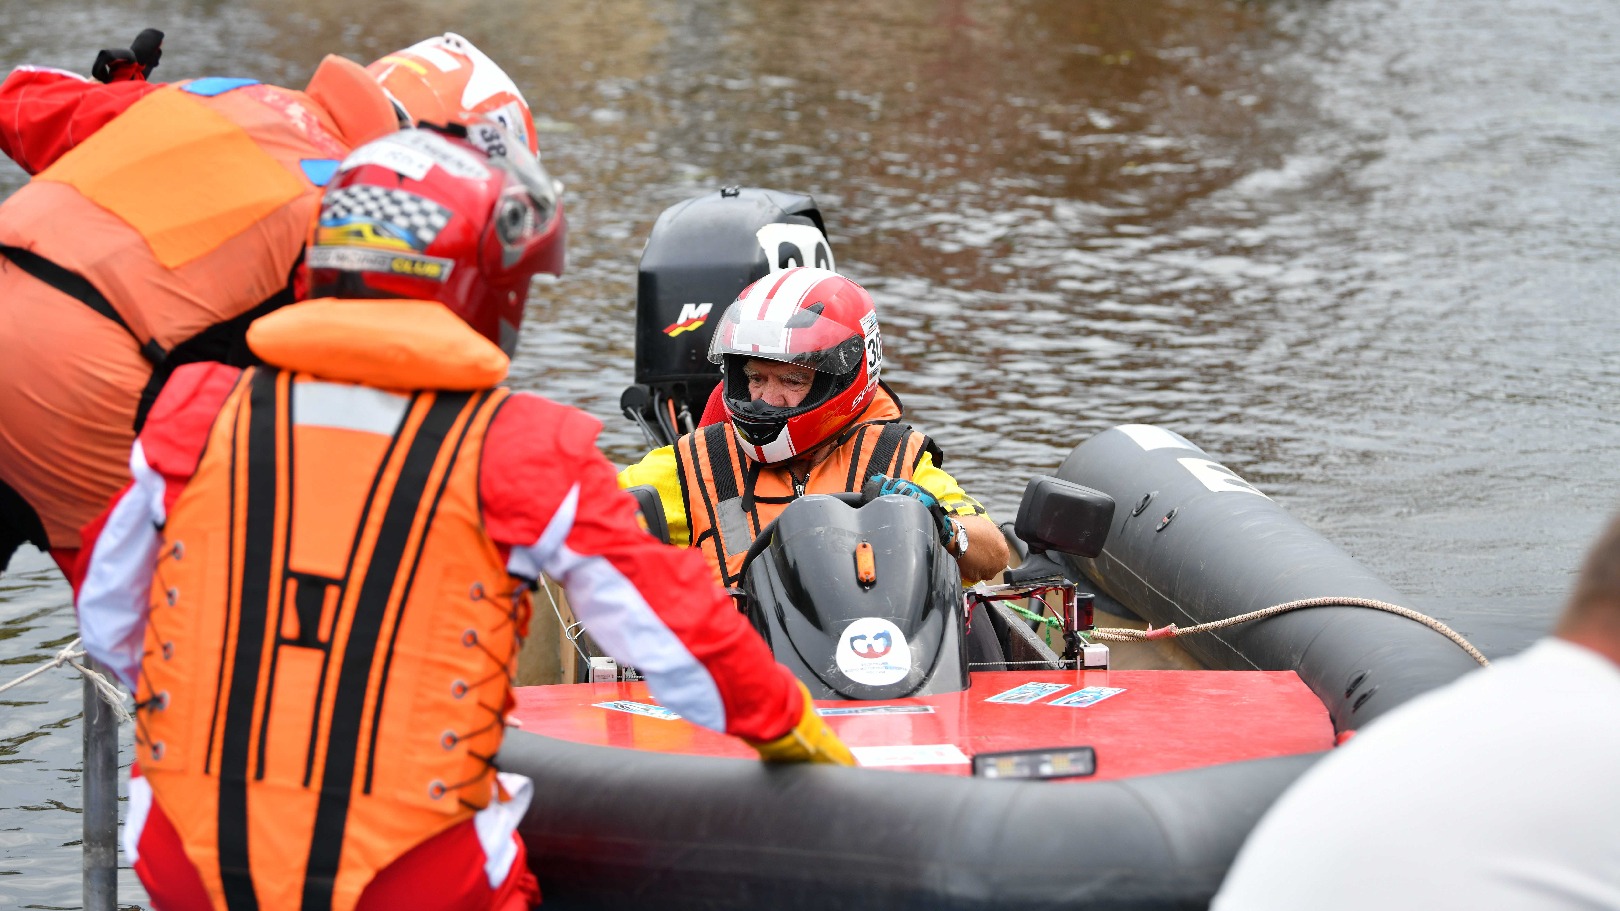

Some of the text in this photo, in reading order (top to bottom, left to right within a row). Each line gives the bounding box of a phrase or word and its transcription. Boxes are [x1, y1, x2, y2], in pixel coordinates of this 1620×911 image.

[391, 256, 441, 278] CLUB
[676, 303, 713, 325] M
[867, 332, 882, 368] 30
